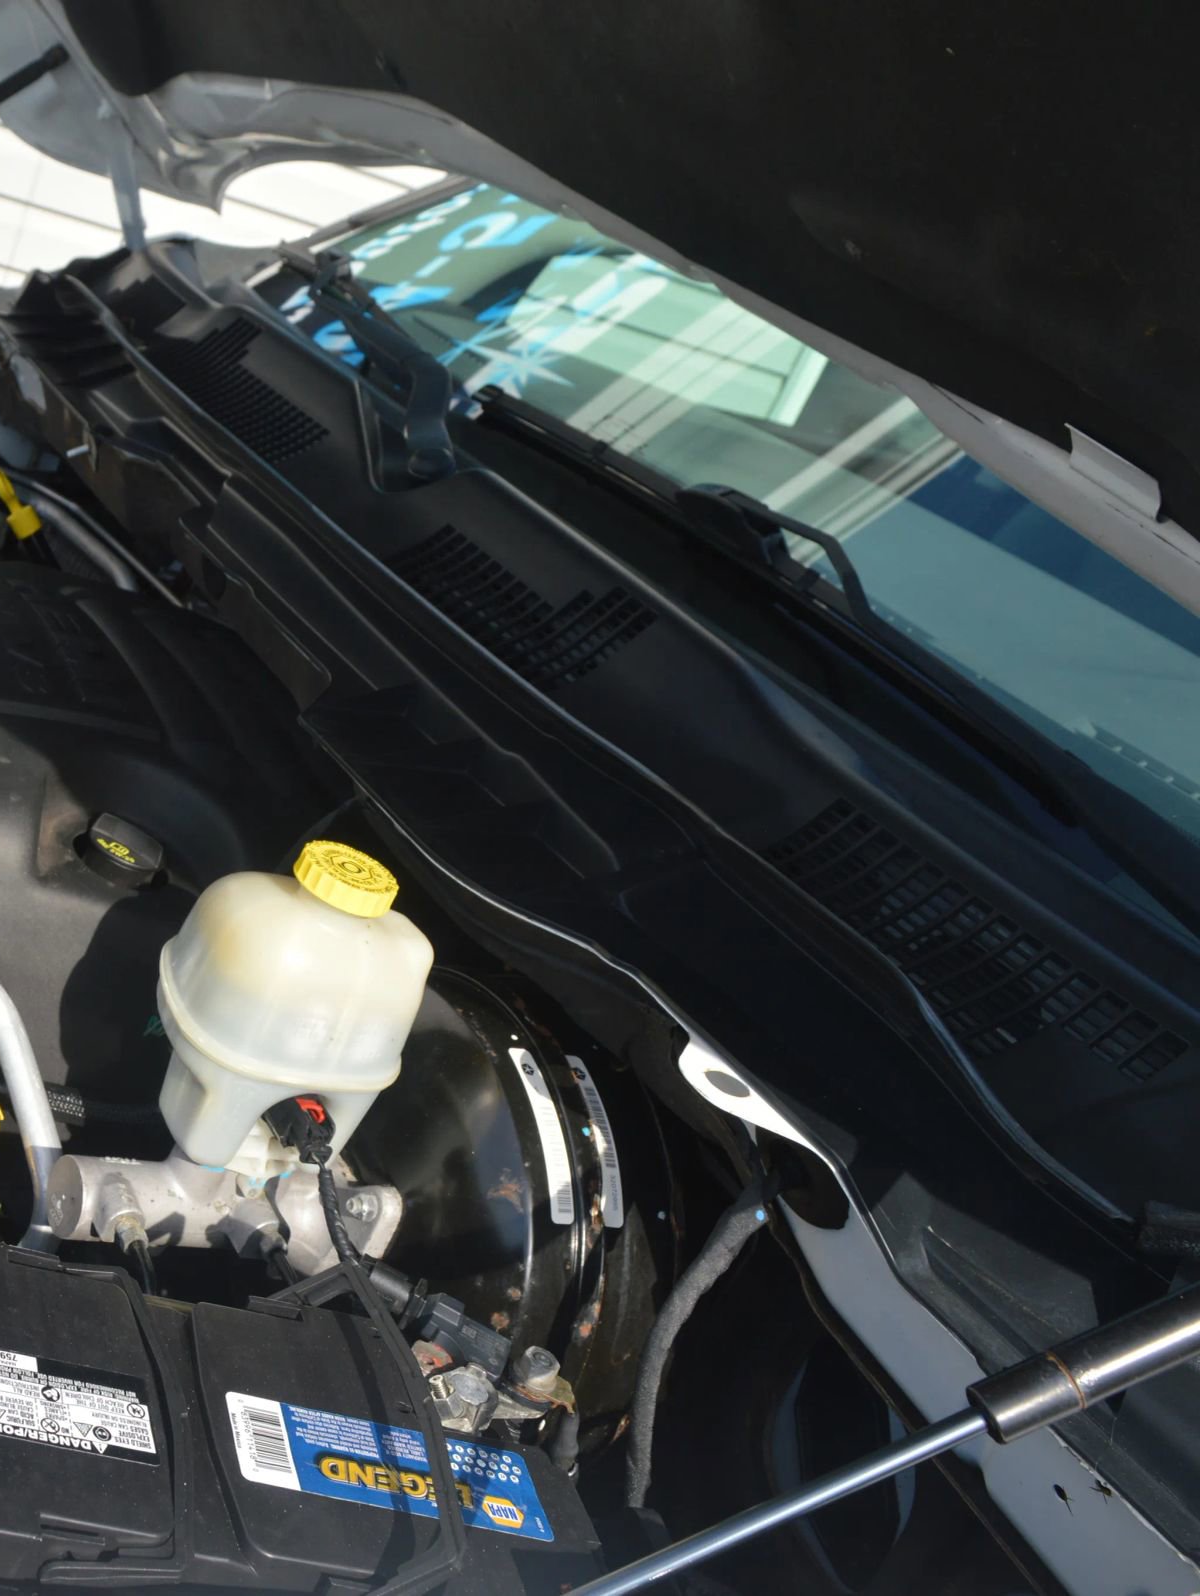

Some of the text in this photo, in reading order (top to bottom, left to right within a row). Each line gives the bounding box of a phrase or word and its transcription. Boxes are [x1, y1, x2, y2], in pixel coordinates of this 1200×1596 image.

[118, 1430, 149, 1441] EXPLOSIVE
[114, 1436, 151, 1449] SHIELD EYES
[487, 1503, 517, 1520] NAPA
